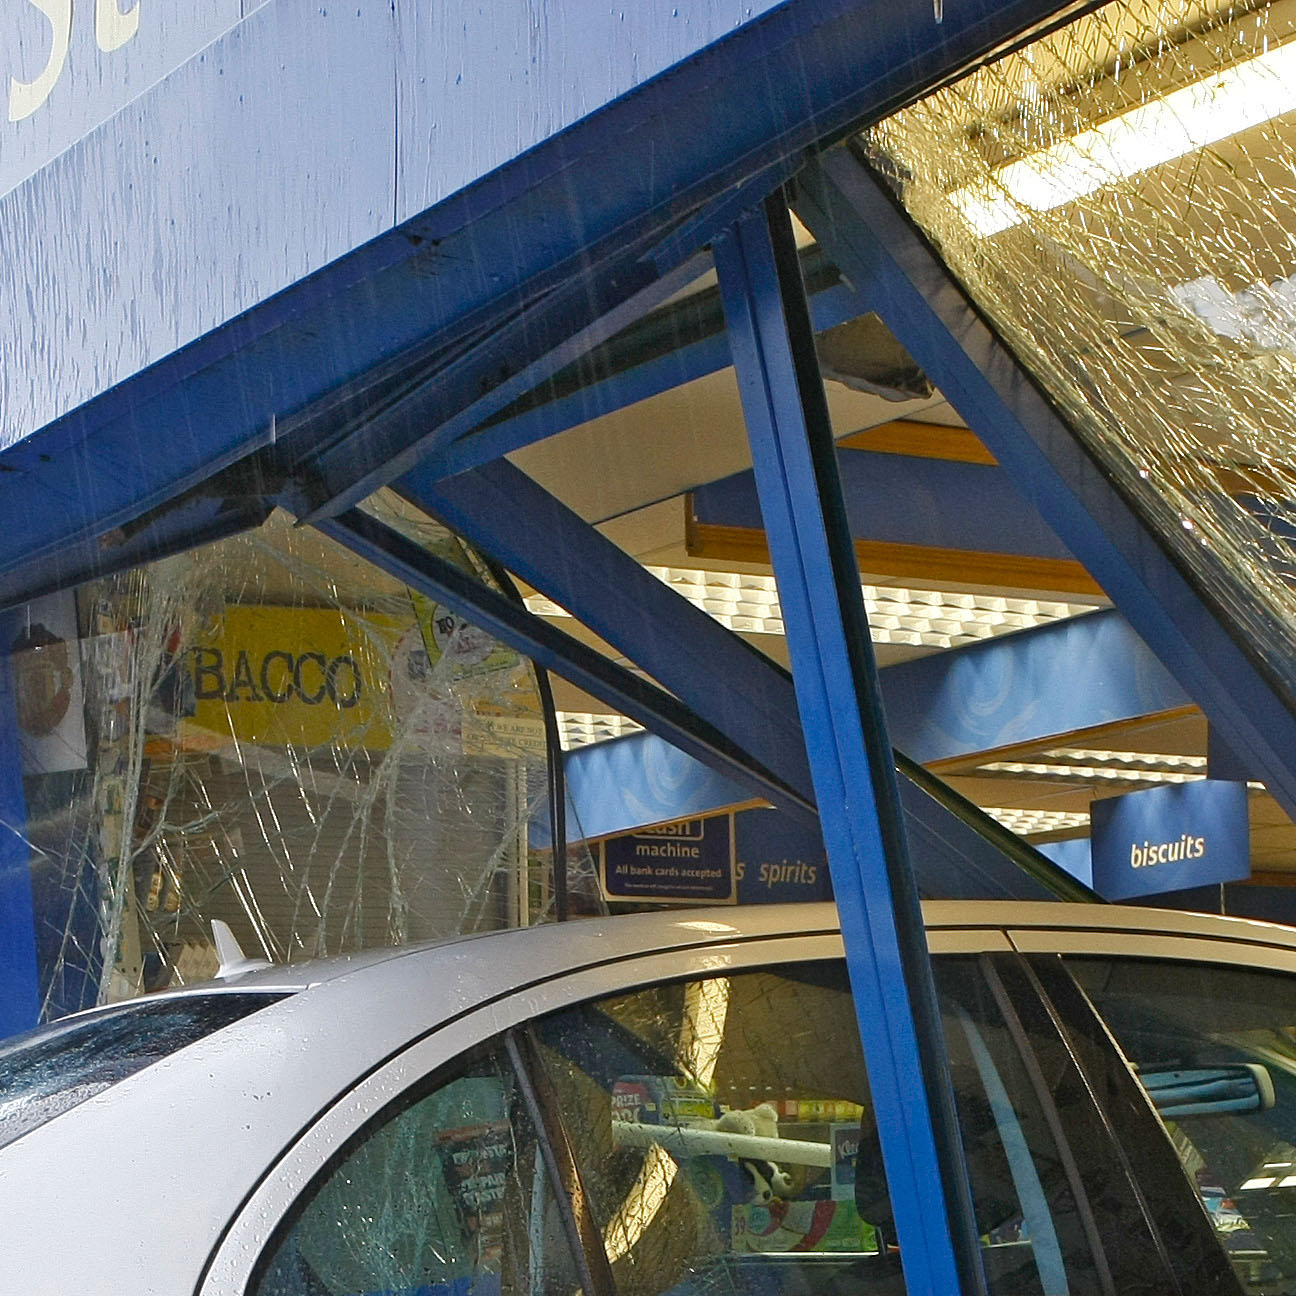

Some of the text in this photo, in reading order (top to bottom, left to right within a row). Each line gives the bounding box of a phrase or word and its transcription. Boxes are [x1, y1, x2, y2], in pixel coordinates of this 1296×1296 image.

[193, 645, 362, 708] BACCO
[635, 842, 700, 858] machine
[1130, 833, 1205, 869] biscuits
[615, 864, 628, 875] All
[630, 864, 653, 876] bank
[655, 866, 679, 876] cards
[681, 868, 722, 880] accepted
[759, 858, 817, 889] spirits
